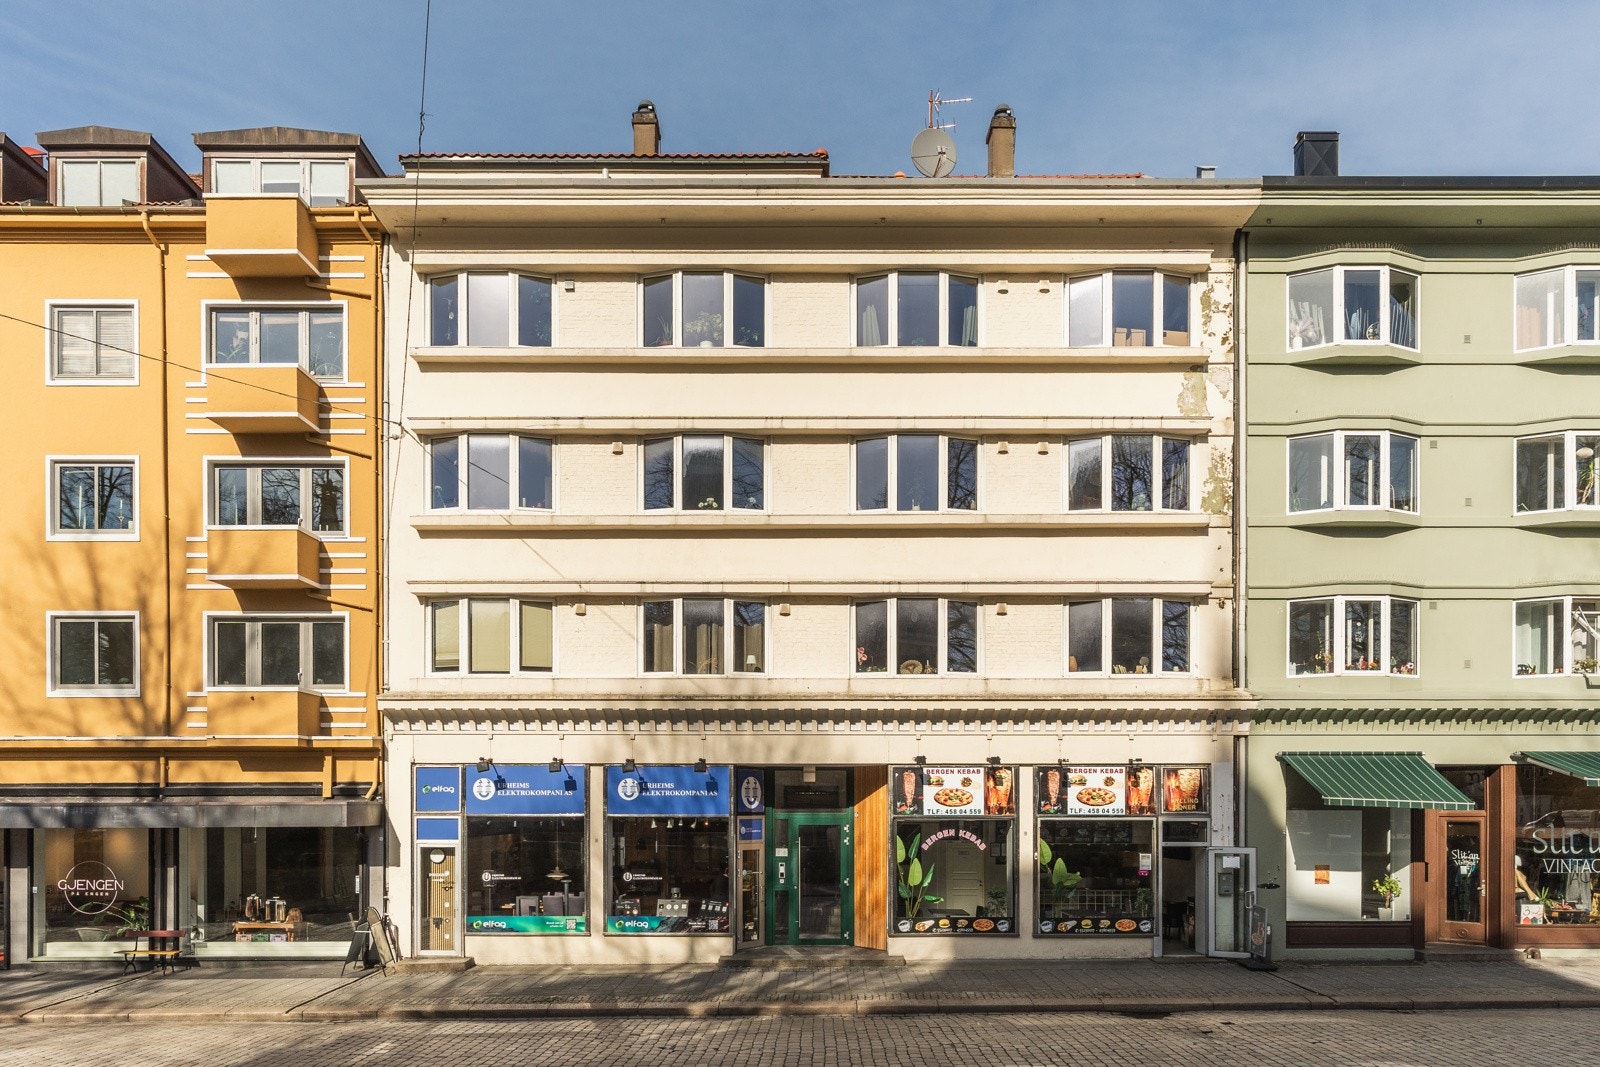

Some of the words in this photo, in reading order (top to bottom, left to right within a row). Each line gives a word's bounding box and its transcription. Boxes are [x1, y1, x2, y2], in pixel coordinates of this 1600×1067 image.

[431, 785, 455, 794] elfag
[921, 828, 956, 851] BERGEN
[958, 829, 987, 851] KEBAB
[57, 879, 124, 891] GJENGEN
[482, 920, 507, 929] elfag
[625, 920, 649, 929] elfag
